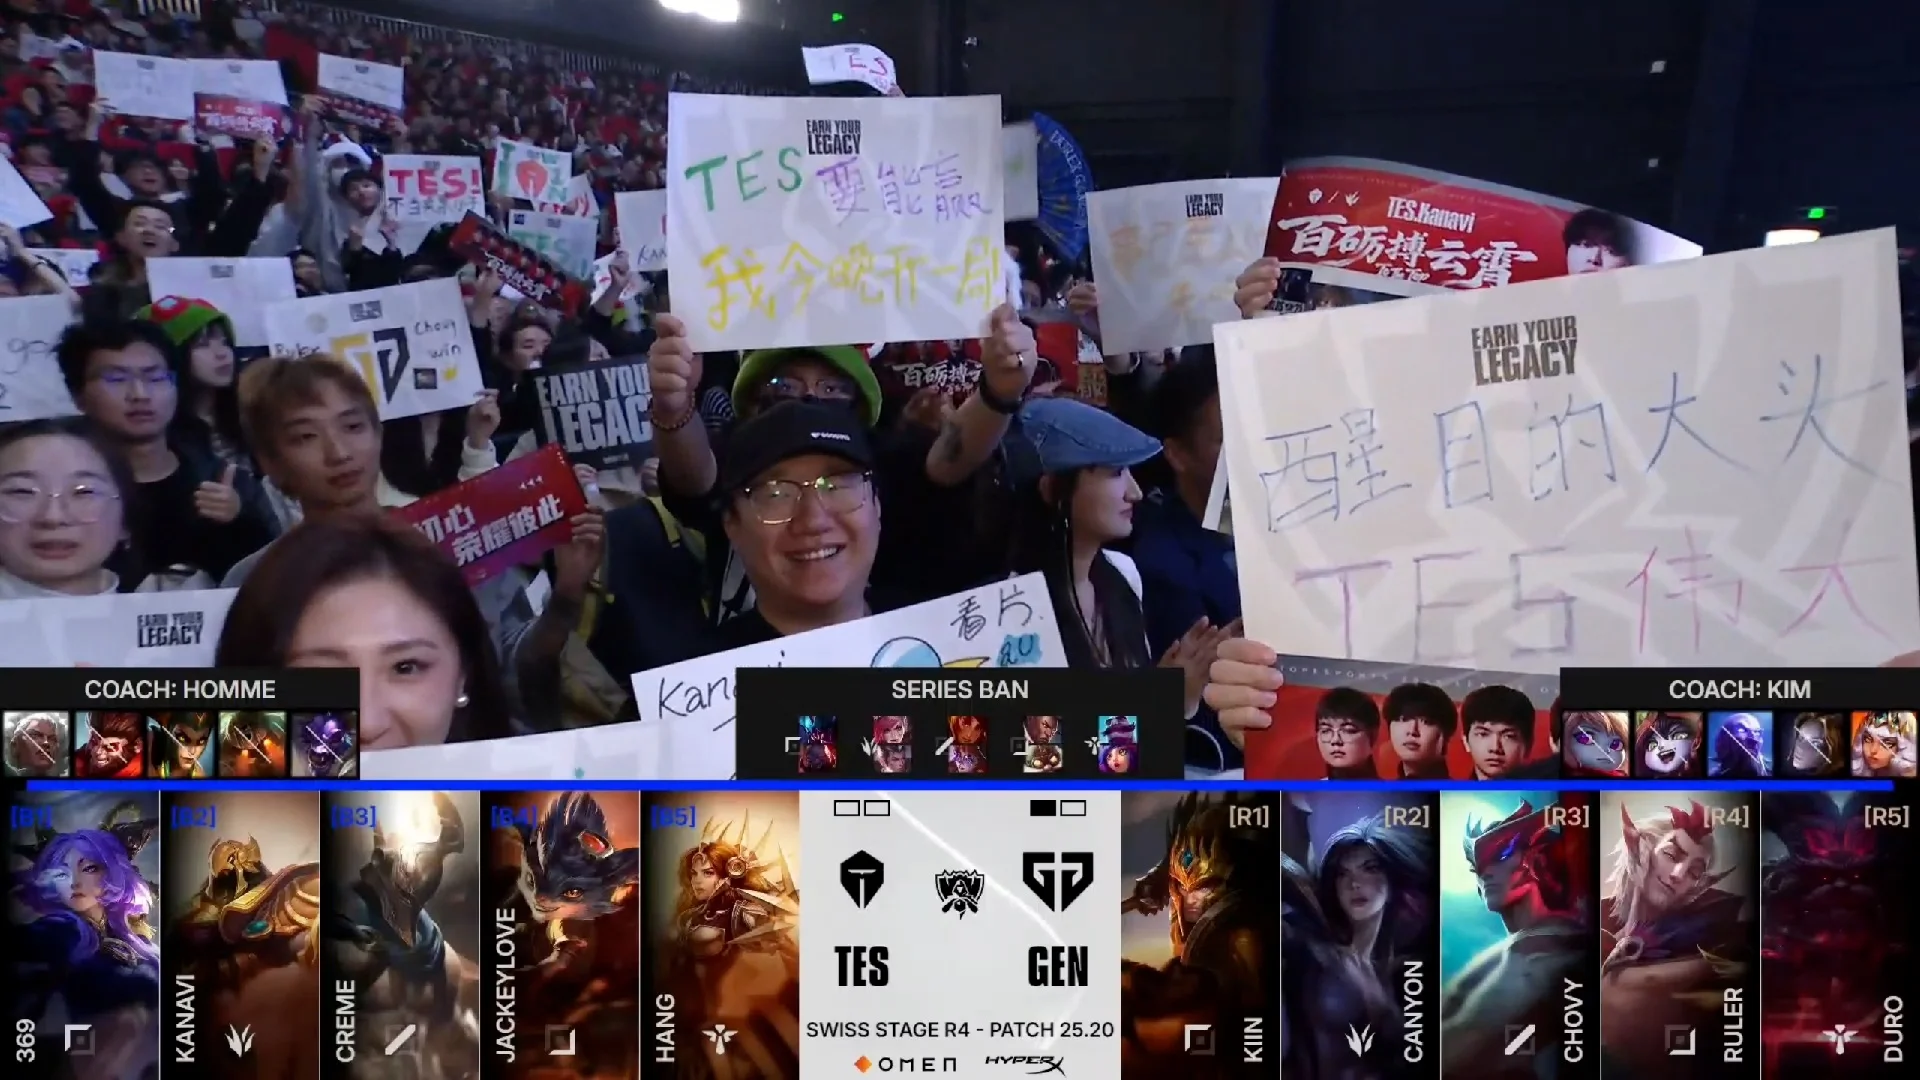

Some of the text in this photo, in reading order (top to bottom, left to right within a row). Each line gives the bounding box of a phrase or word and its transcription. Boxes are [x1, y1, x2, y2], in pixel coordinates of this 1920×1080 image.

[806, 119, 861, 134] EARN YOUR
[807, 134, 861, 155] LEGACY
[388, 167, 481, 199] TES!
[685, 147, 803, 212] TES
[1186, 202, 1224, 217] LEGACY
[1387, 195, 1476, 233] TES.Kanavi
[1471, 315, 1577, 349] EARN YOUR
[1472, 339, 1578, 386] LEGACY
[535, 363, 652, 408] EARN YOU
[541, 394, 654, 453] LEGAC
[1260, 353, 1904, 532] 醒目的大头
[1626, 518, 1900, 654] 伟大
[137, 626, 203, 648] LEGACY
